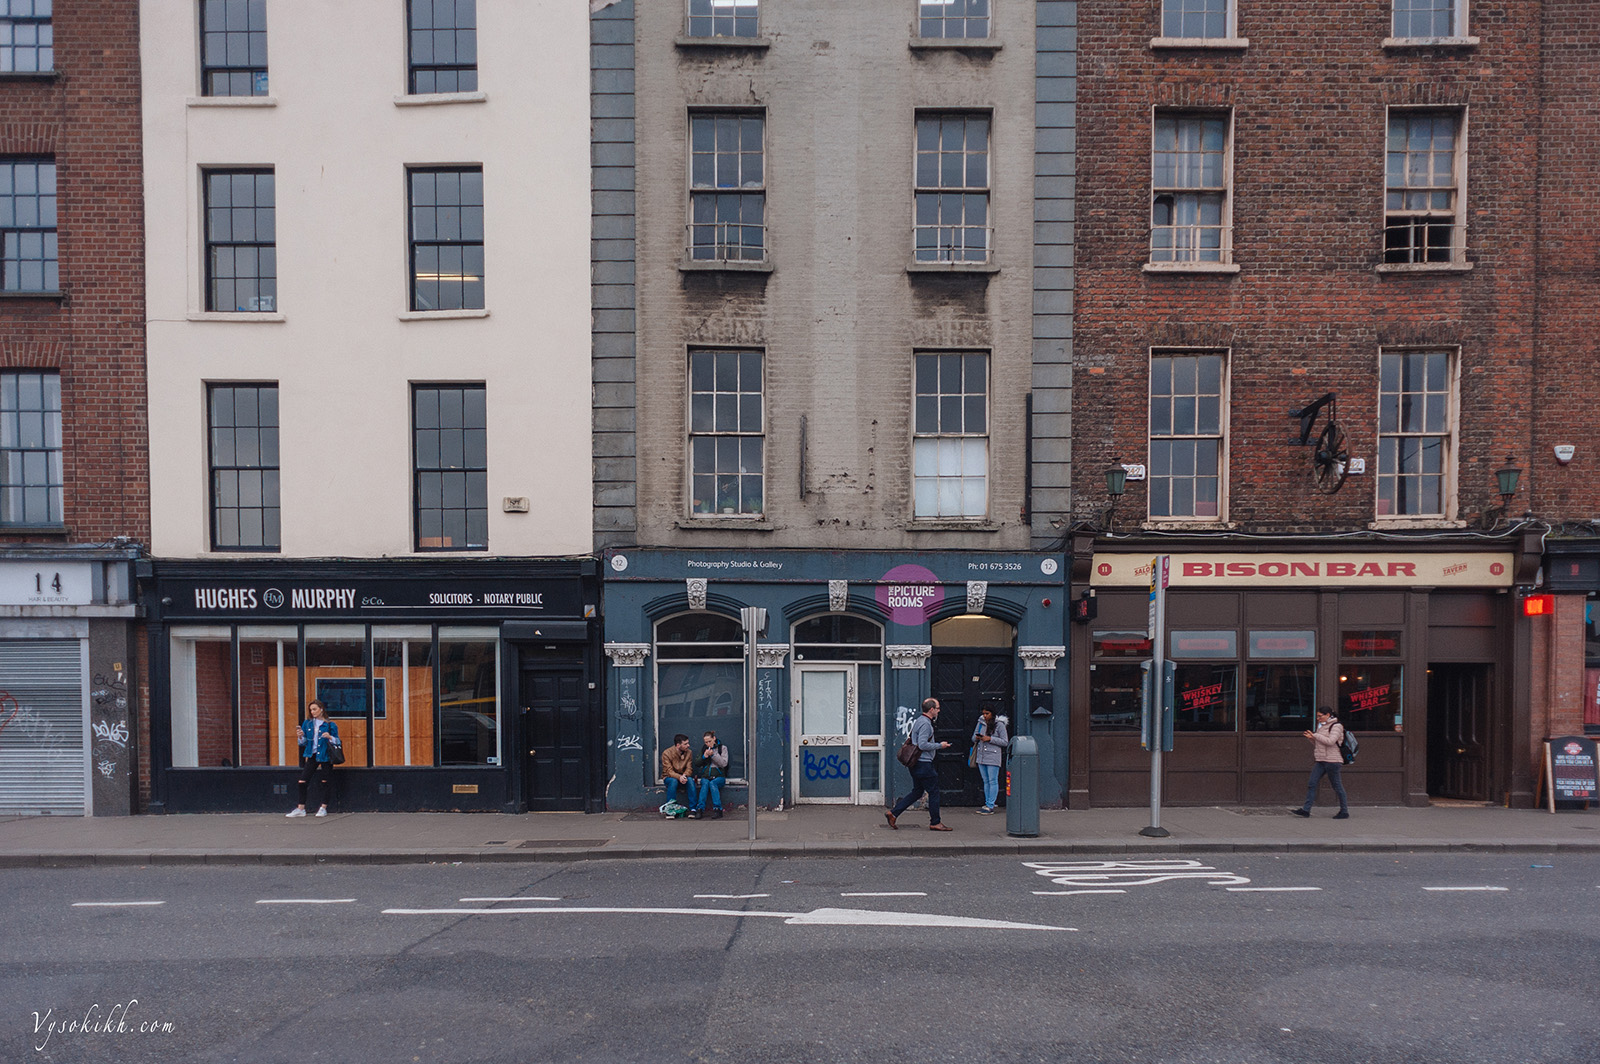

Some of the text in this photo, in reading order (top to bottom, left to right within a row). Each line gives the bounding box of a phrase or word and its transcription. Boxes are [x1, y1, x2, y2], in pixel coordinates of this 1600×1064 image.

[687, 560, 730, 569] Photography
[730, 560, 752, 568] Studio
[760, 561, 783, 570] Gallery
[1183, 562, 1320, 577] BISON
[1326, 562, 1417, 577] BAR
[1442, 563, 1468, 575] TAVERN
[894, 585, 935, 597] PICTURE
[195, 588, 258, 609] HUGHES
[292, 588, 356, 609] MURPHY
[429, 593, 473, 604] SOLICITORS
[484, 593, 514, 604] NOTARY
[515, 593, 543, 604] PUBLIC
[888, 596, 924, 608] ROOMS
[1183, 685, 1222, 701] WHISKEY
[1350, 687, 1390, 702] WHISKEY
[1192, 696, 1211, 707] BAR
[1361, 697, 1378, 708] BAR
